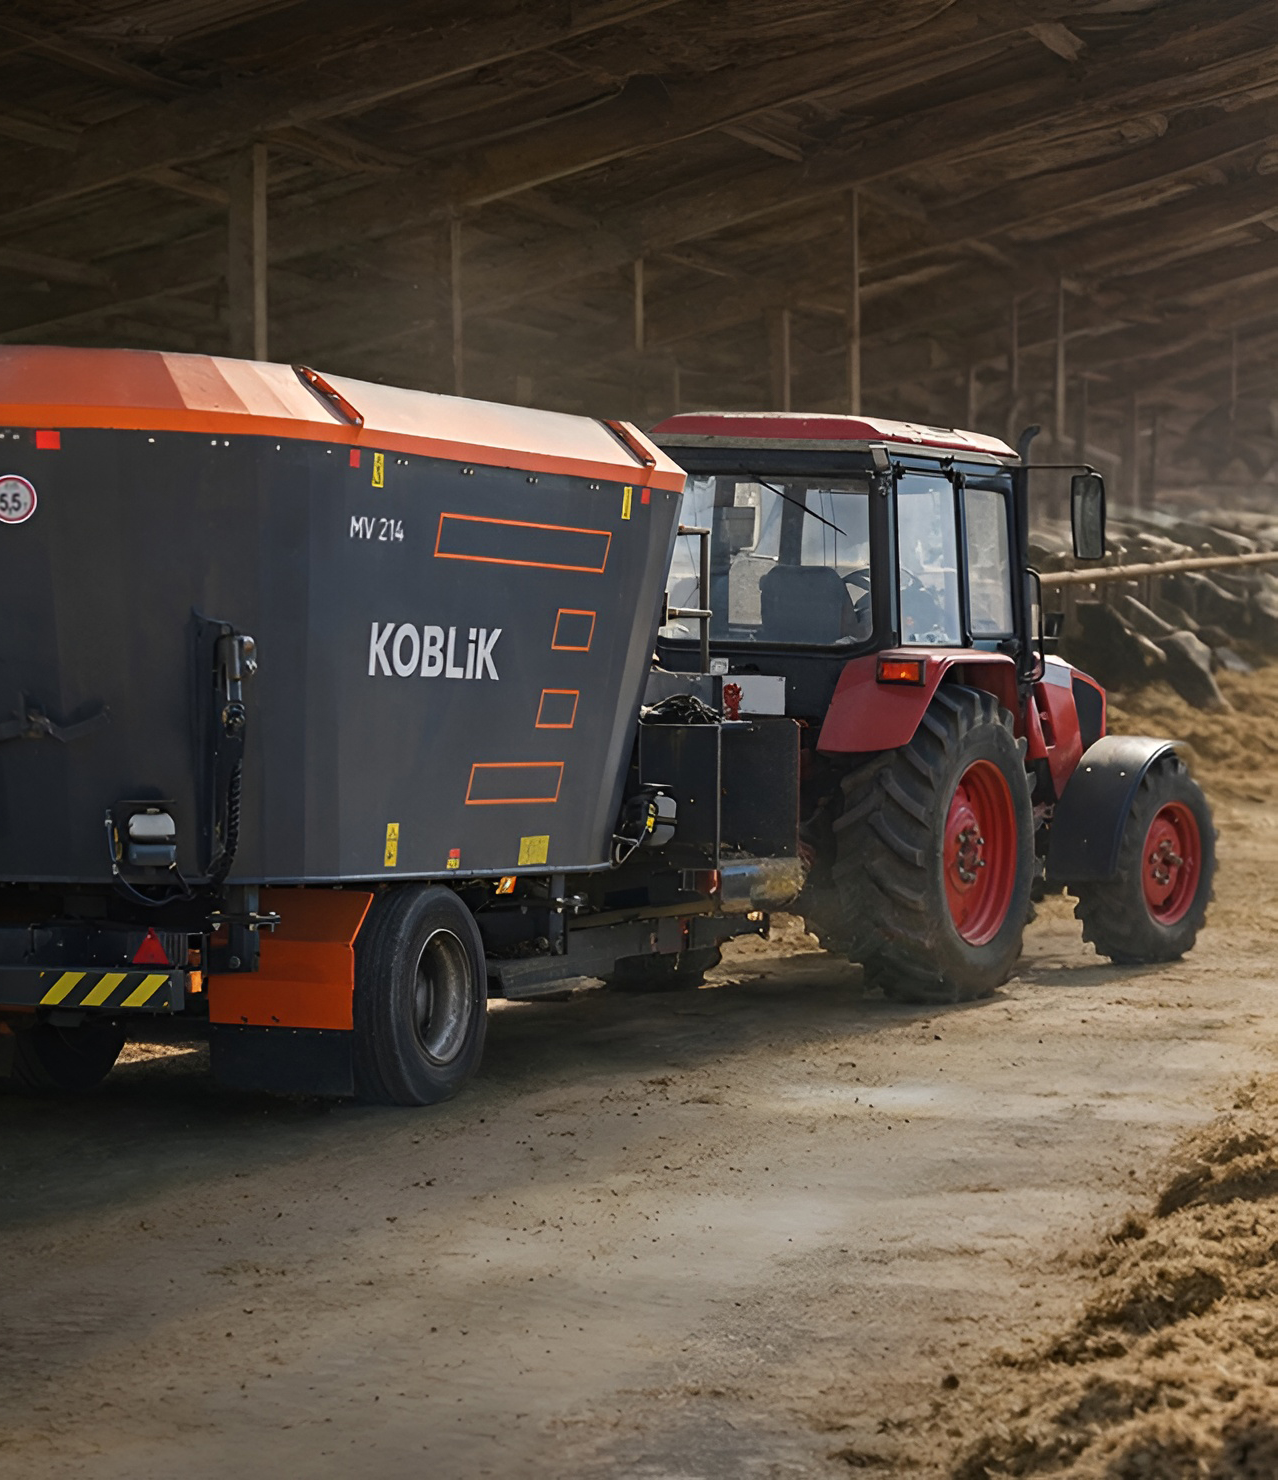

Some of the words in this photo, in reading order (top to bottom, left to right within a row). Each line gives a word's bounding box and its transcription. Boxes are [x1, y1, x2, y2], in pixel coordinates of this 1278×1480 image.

[0, 493, 22, 515] 5,5
[350, 516, 376, 539] MV
[379, 518, 404, 541] 214
